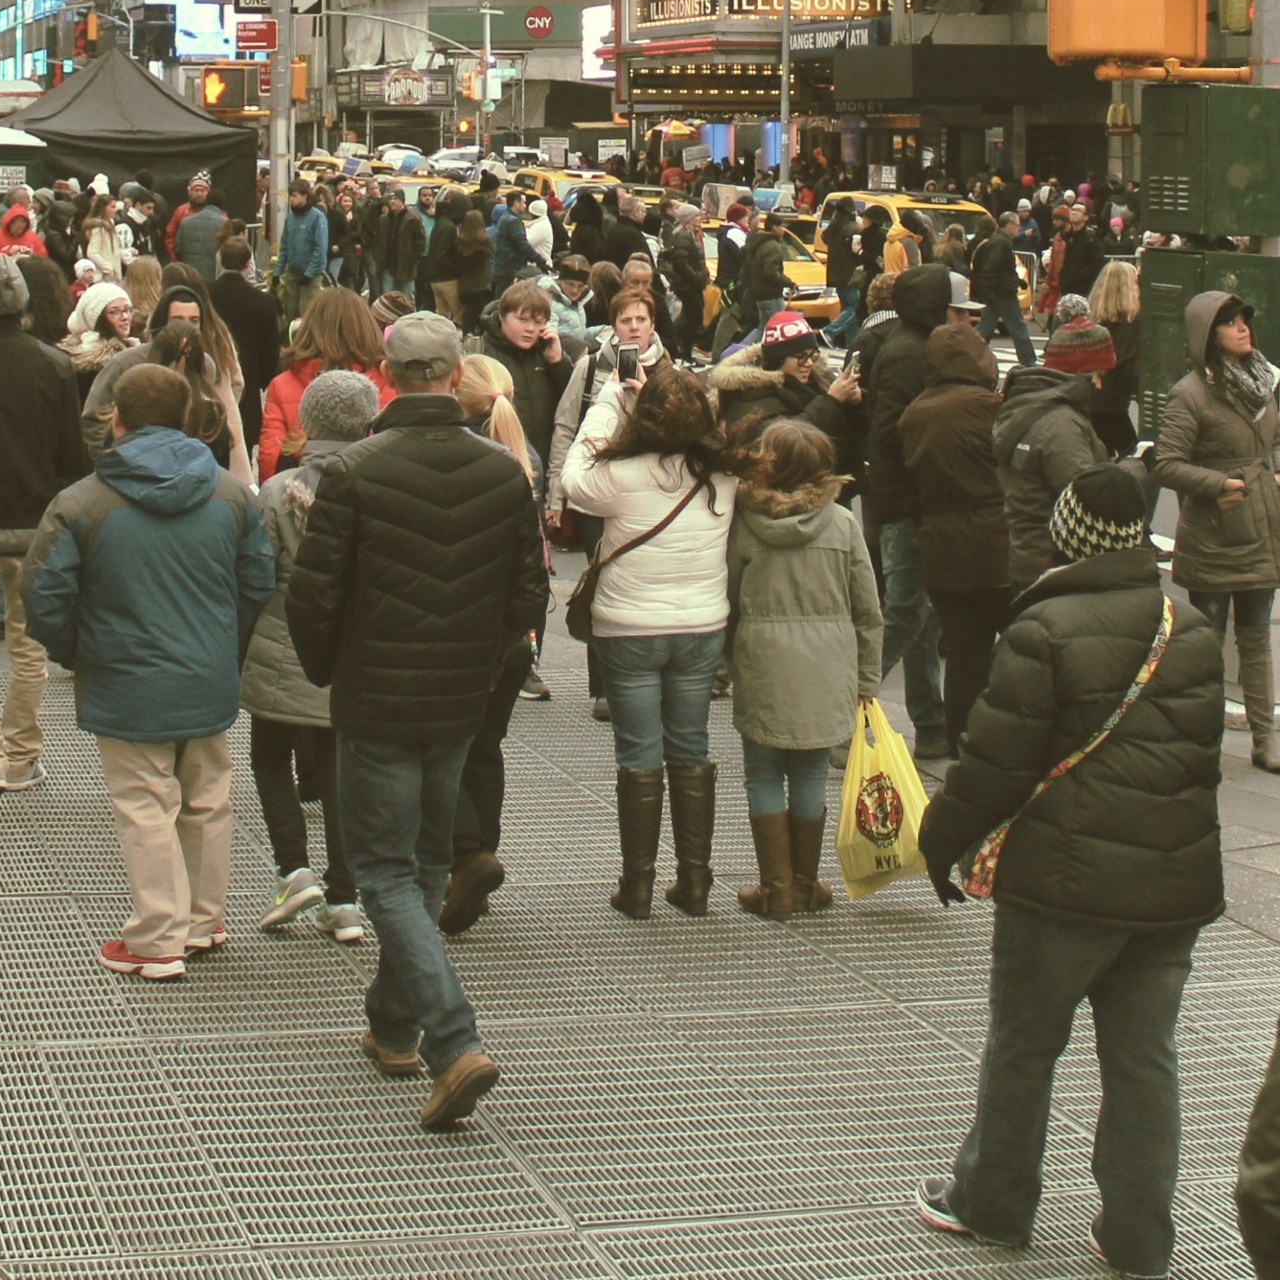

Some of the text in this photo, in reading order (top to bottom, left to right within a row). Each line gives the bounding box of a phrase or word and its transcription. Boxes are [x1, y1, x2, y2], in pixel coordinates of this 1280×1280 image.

[525, 16, 551, 29] CNY
[816, 28, 869, 49] MONEY ATM
[835, 101, 884, 113] MONEY
[1, 168, 25, 176] FLUSH
